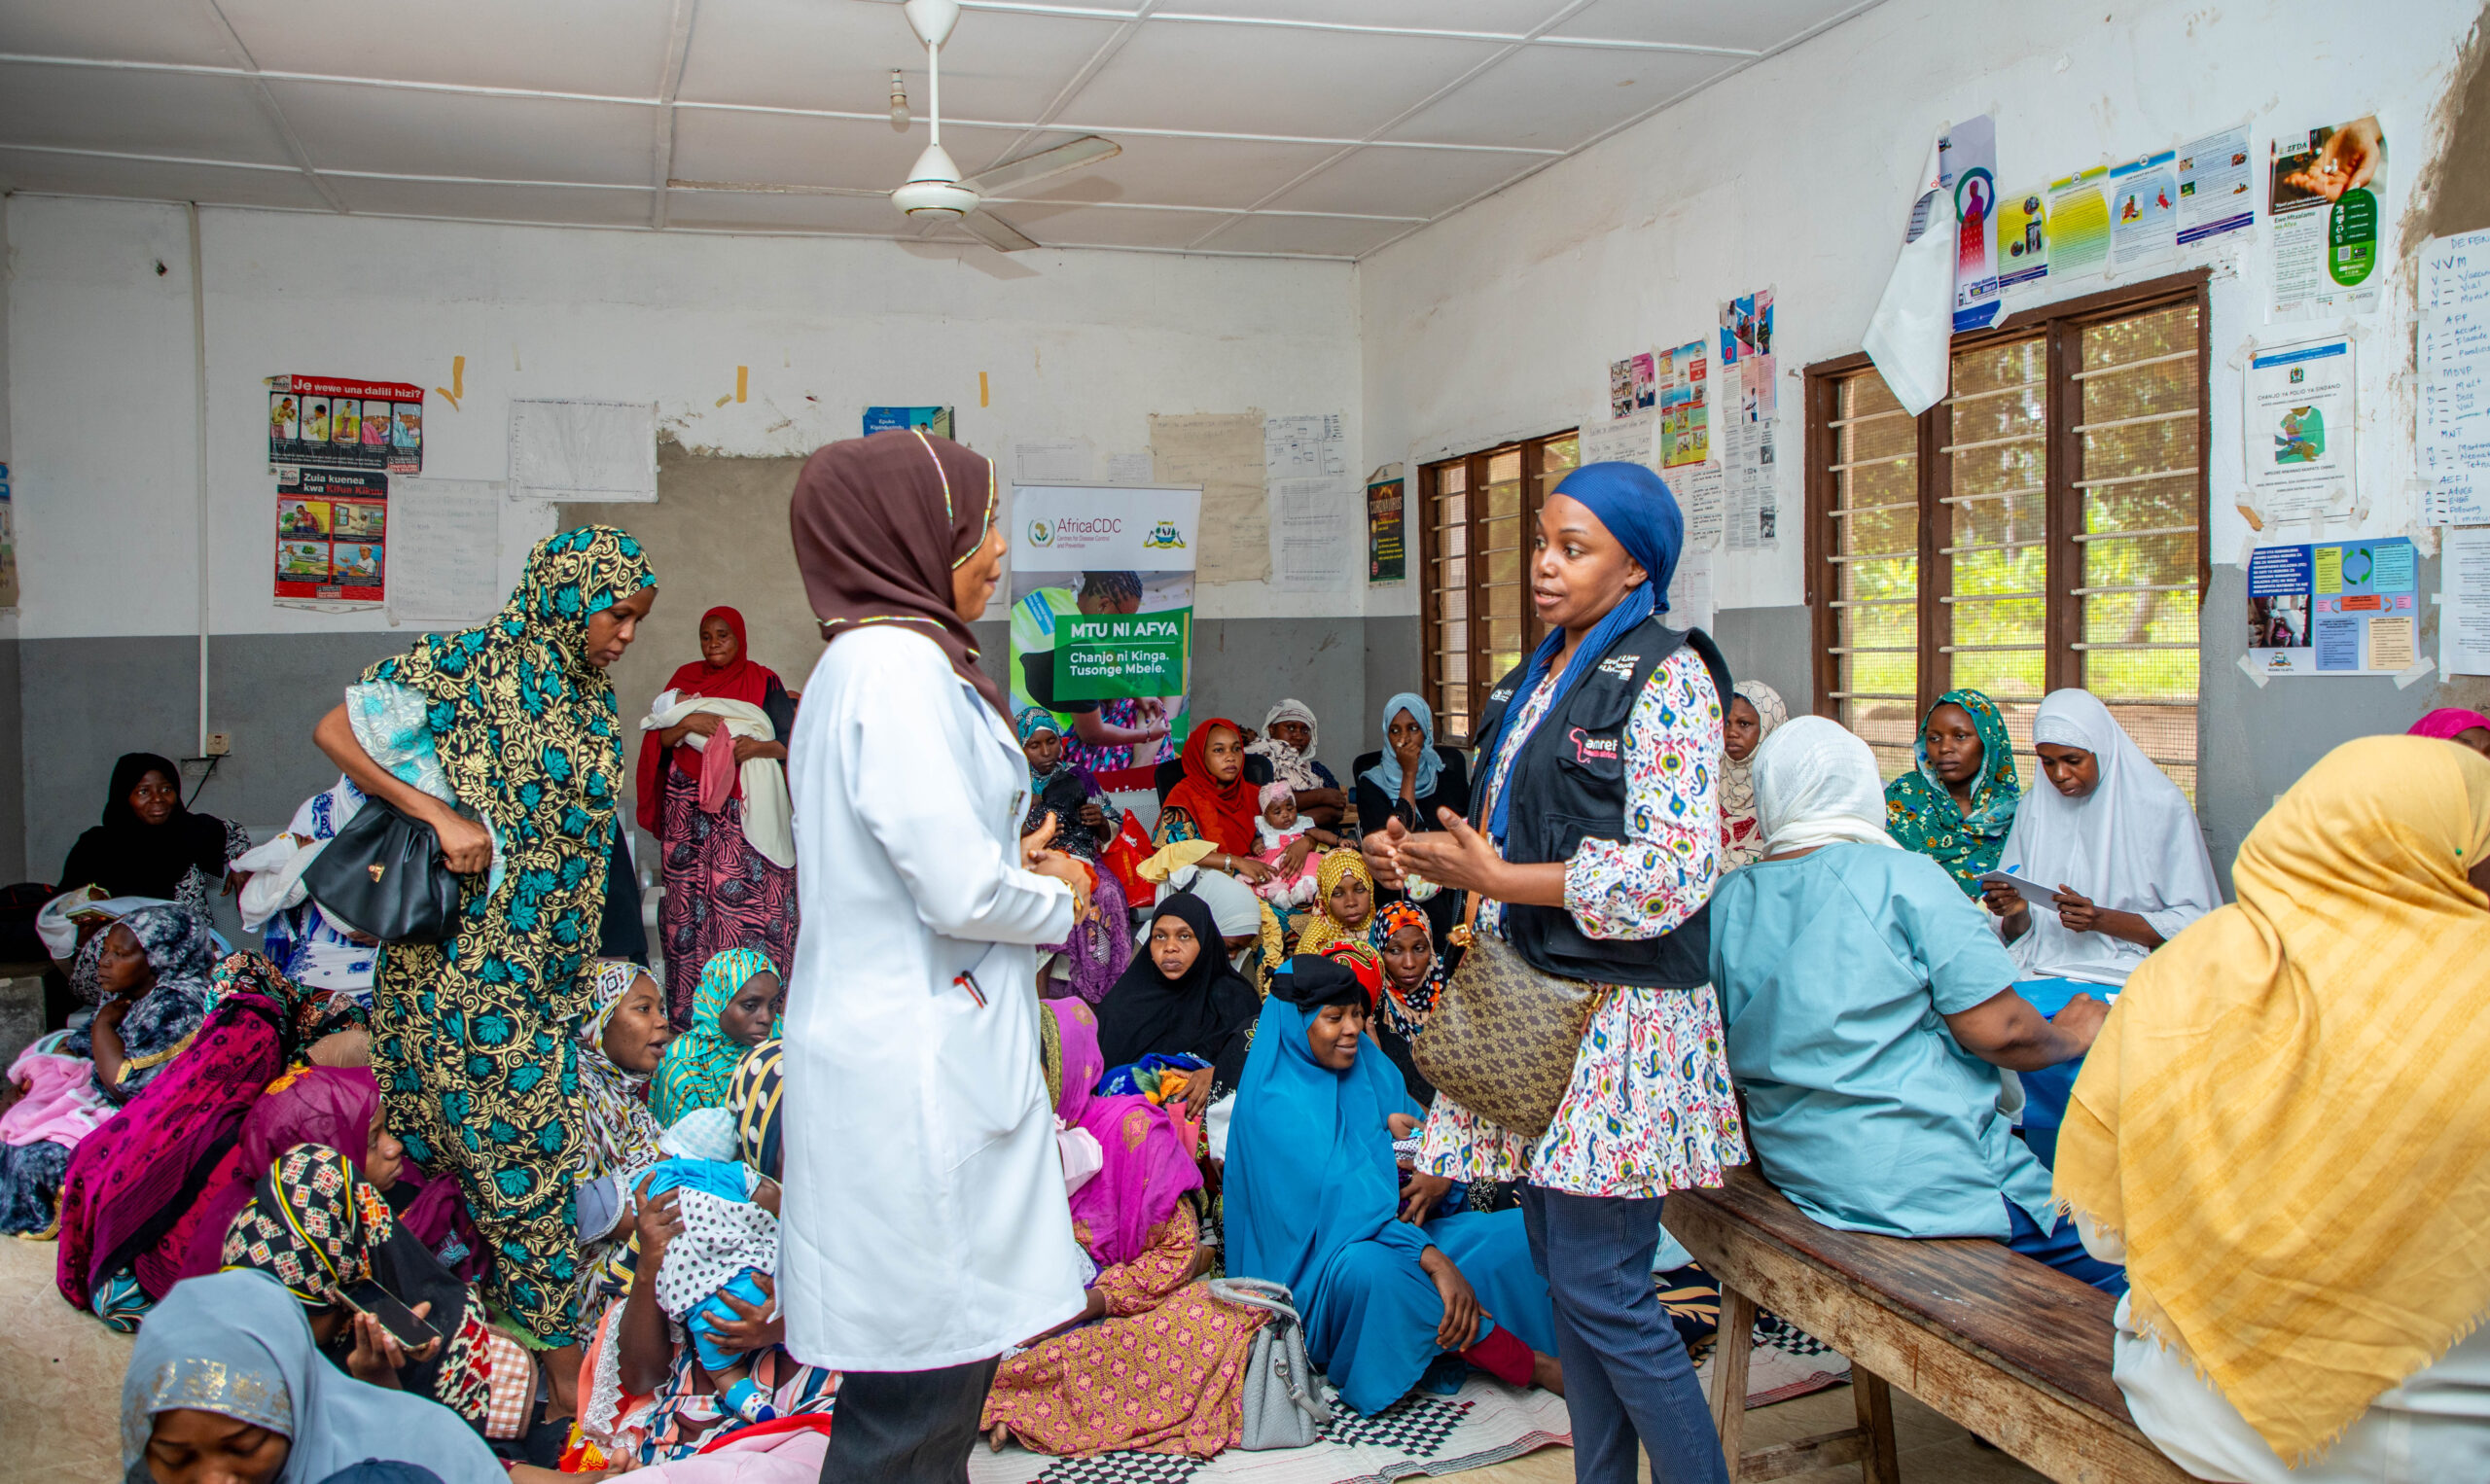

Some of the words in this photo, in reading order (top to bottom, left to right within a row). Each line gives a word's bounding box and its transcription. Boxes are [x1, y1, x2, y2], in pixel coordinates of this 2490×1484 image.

[2287, 141, 2307, 153] ZFDA
[293, 379, 311, 391] Je
[314, 383, 342, 393] wewe
[344, 386, 363, 395] una
[364, 385, 391, 397] dalili
[395, 386, 421, 399] hizi?
[2315, 383, 2341, 393] SINDANO
[303, 473, 327, 482] Zuia
[329, 475, 365, 485] kuenea
[303, 482, 324, 493] kwa
[327, 484, 353, 495] Kifua
[355, 484, 383, 496] Kikuu
[1071, 622, 1108, 638] MTU
[1113, 622, 1130, 637] NI
[1134, 621, 1179, 636] AFYA
[1070, 652, 1114, 665] Chanjo
[1117, 651, 1128, 661] ni
[1131, 650, 1169, 663] Kinga.
[1070, 665, 1122, 677] Tusonge
[1125, 661, 1165, 675] Mbele.
